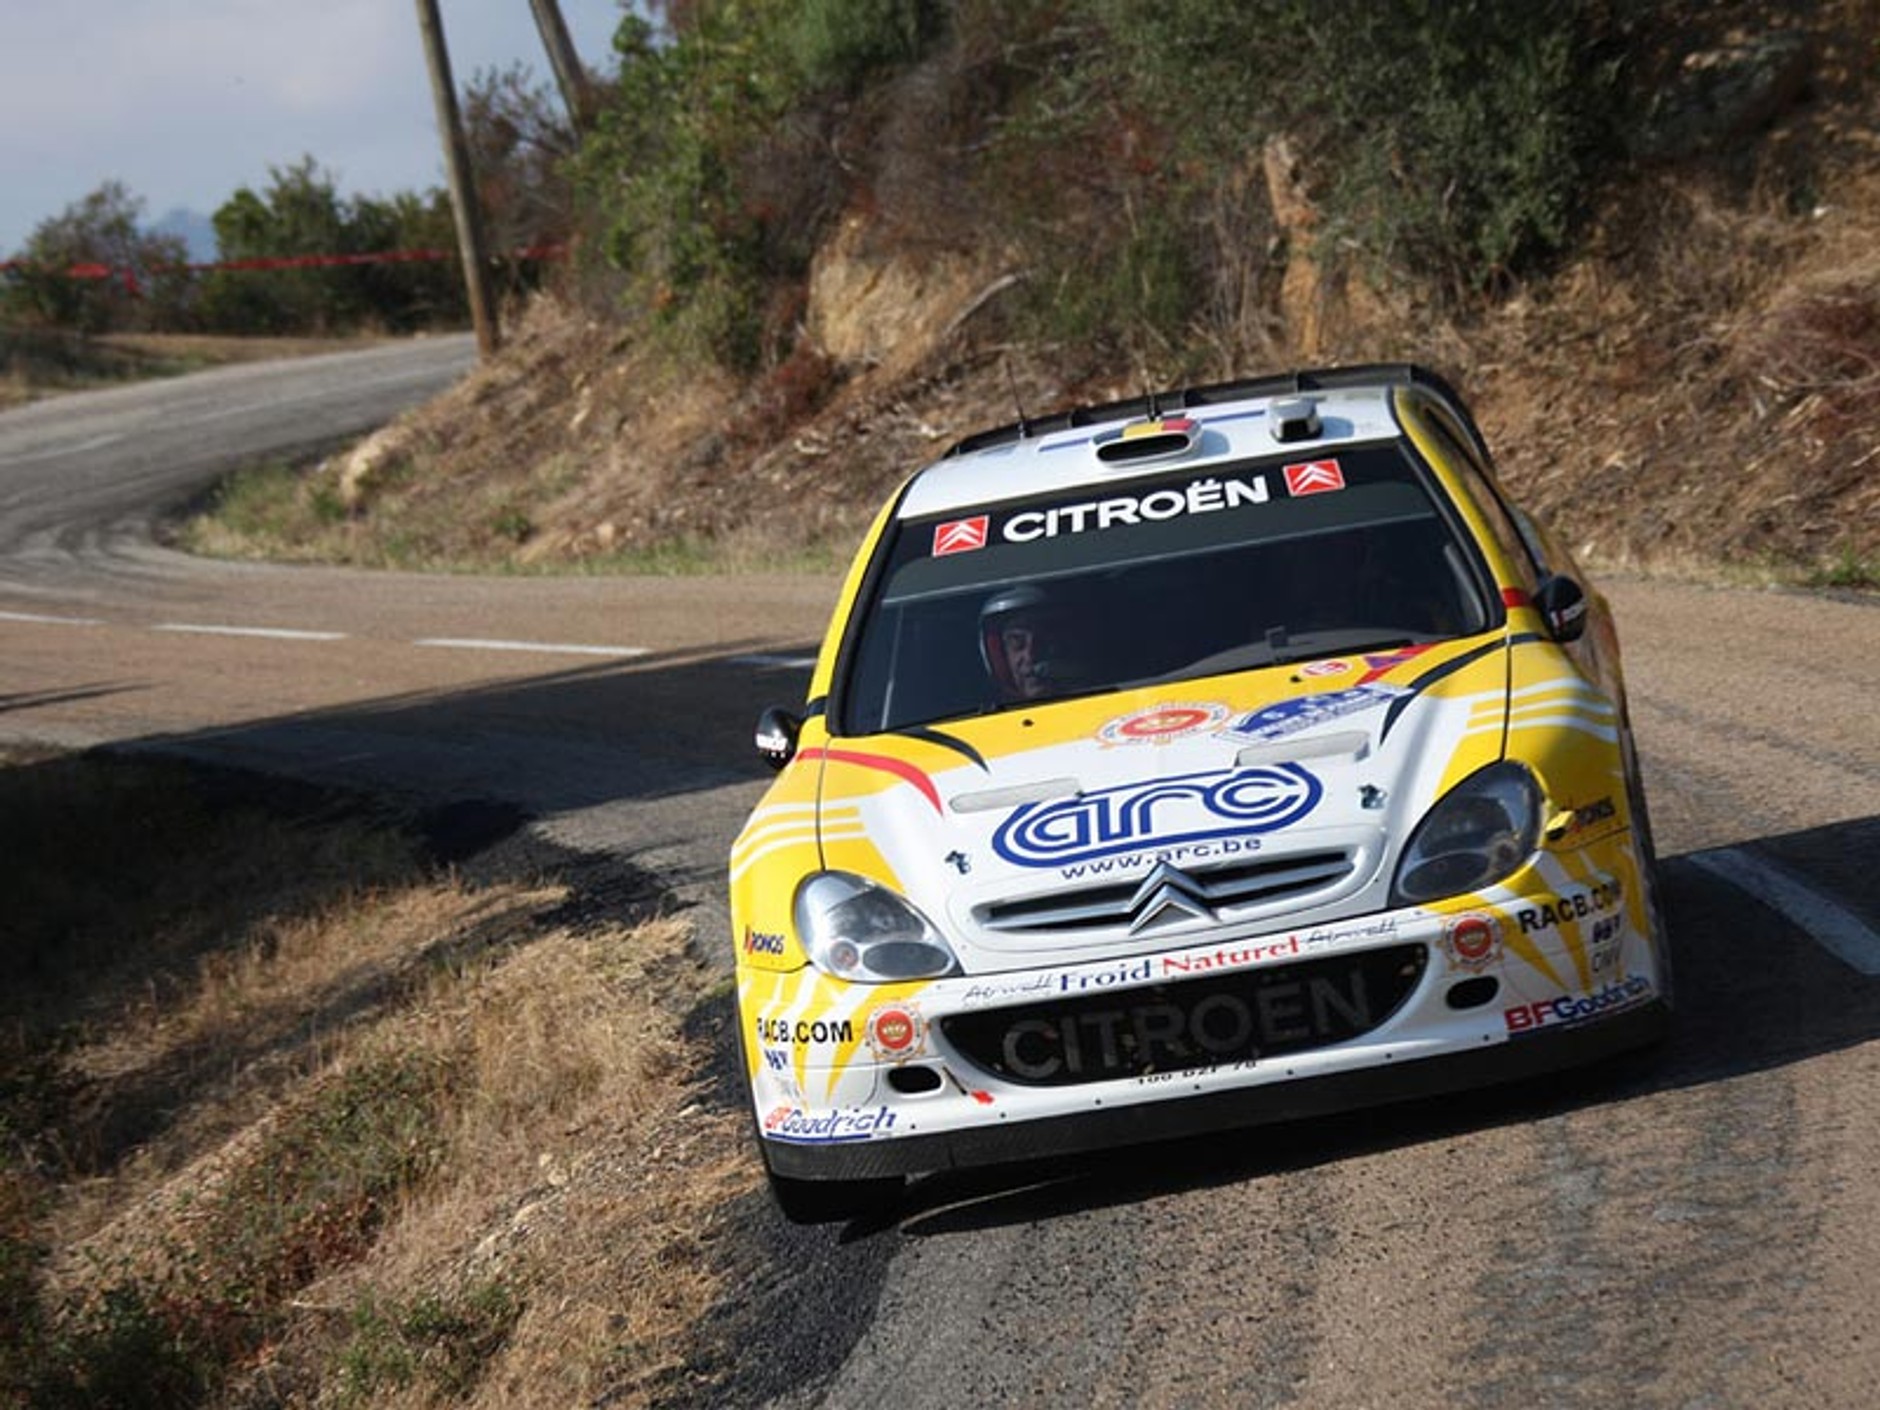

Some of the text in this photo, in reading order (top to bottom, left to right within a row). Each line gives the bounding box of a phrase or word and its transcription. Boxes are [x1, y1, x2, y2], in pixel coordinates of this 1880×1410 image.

[1003, 474, 1269, 542] CITROËN
[1009, 767, 1304, 856] arc
[1061, 837, 1261, 880] www.arc.be
[1060, 959, 1151, 991] Froid
[1161, 935, 1299, 977] Naturel
[1003, 970, 1371, 1080] CITROËN
